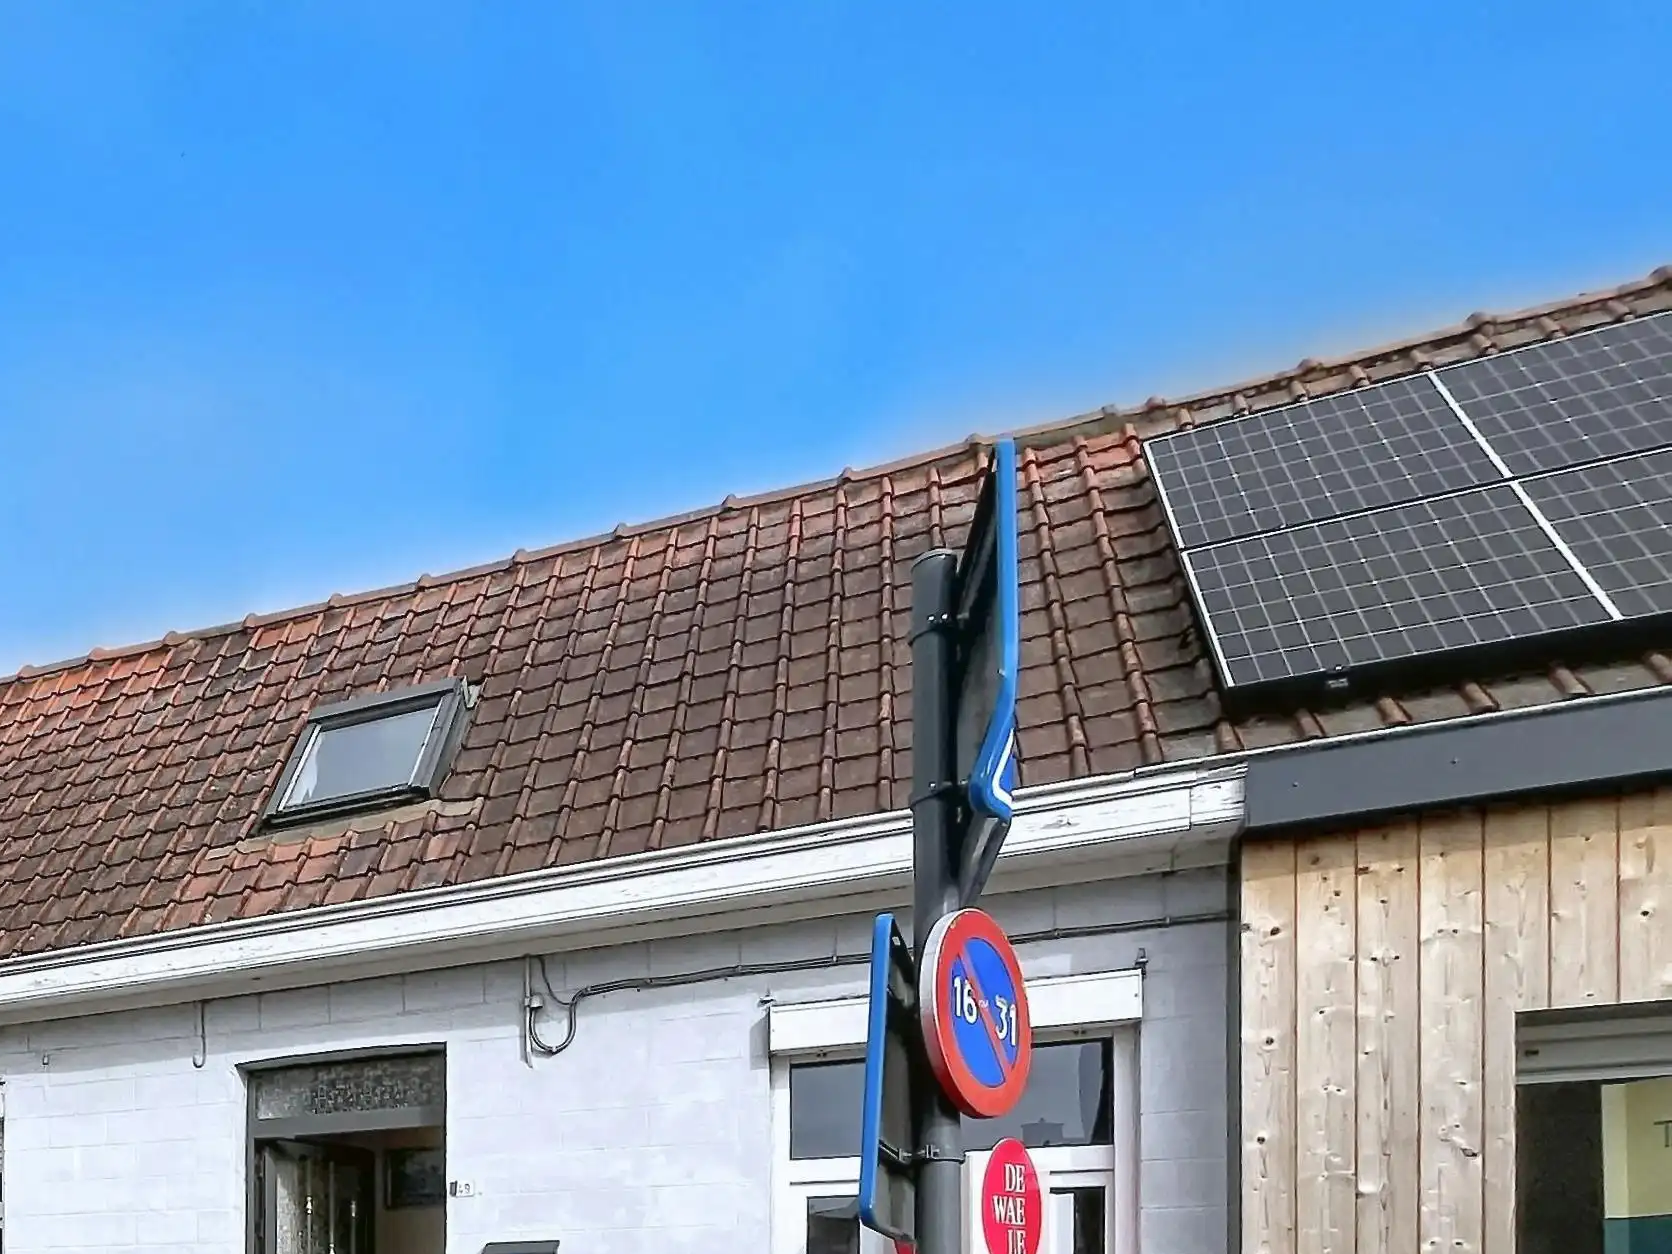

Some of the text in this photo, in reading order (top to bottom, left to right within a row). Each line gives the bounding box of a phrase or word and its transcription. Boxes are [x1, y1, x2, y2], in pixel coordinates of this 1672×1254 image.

[953, 976, 978, 1024] 16
[995, 994, 1017, 1046] 31
[1004, 1162, 1026, 1193] DE
[992, 1195, 1026, 1226] WAE
